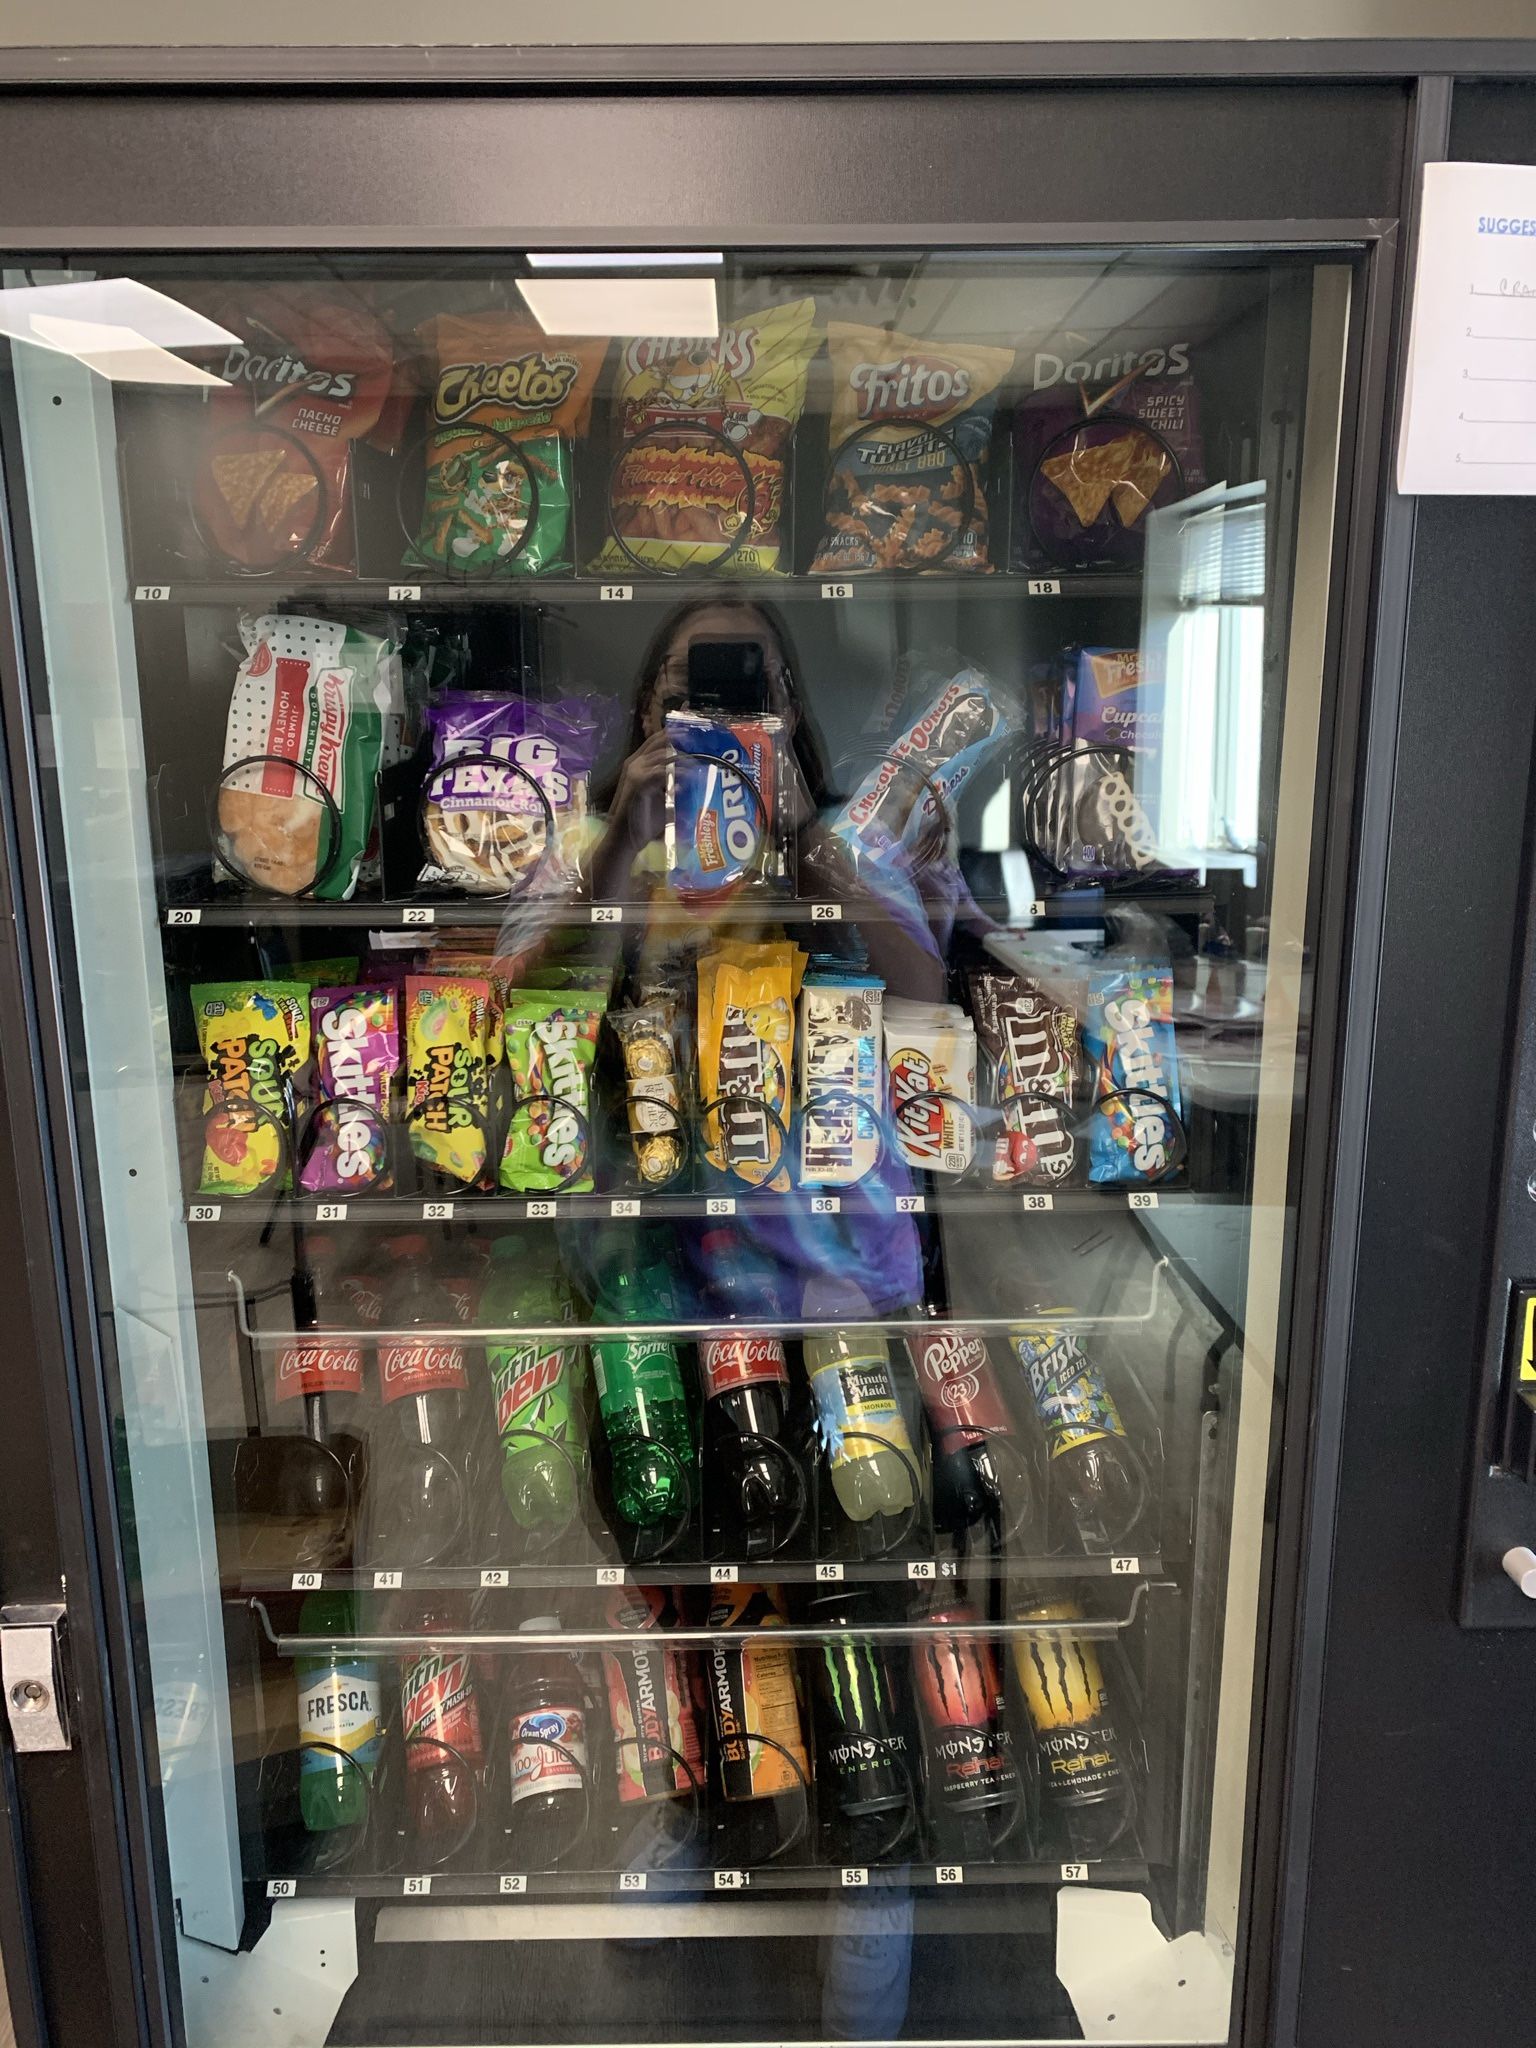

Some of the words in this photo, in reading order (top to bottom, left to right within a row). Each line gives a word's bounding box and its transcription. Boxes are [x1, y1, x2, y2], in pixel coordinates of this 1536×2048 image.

[222, 344, 356, 397] Doritos
[1033, 343, 1190, 391] Doritos
[435, 355, 572, 418] Cheetos
[849, 356, 972, 419] Fritos
[1147, 395, 1186, 408] SPICY
[297, 408, 342, 425] NACHO
[1138, 407, 1185, 419] SWEET
[292, 418, 340, 437] CHEESE
[1150, 419, 1185, 431] CHILI
[736, 550, 756, 563] 270
[143, 587, 163, 600] 10
[394, 588, 413, 600] 12
[606, 587, 625, 600] 14
[827, 585, 846, 598] 16
[1033, 581, 1053, 594] 18
[319, 673, 345, 736] Krispy
[275, 690, 290, 733] HONEY
[909, 684, 961, 750] DONUTS
[1102, 706, 1162, 727] Cupca
[443, 737, 560, 766] BIG
[430, 763, 569, 803] TEXAS
[440, 796, 516, 809] Cinnamon
[720, 749, 757, 861] OREO
[174, 911, 193, 923] 20
[407, 910, 427, 922] 22
[595, 909, 614, 921] 24
[815, 906, 835, 918] 26
[285, 998, 304, 1022] SOUR
[248, 1039, 286, 1125] SOUR
[1104, 998, 1168, 1172] Skittles
[321, 1008, 377, 1180] Skittles
[535, 1021, 587, 1167] Skittles
[943, 1119, 955, 1150] WHITE
[948, 1155, 956, 1168] 220
[711, 1201, 728, 1212] 35
[815, 1199, 833, 1211] 36
[900, 1198, 917, 1210] 37
[1028, 1197, 1046, 1208] 38
[1133, 1195, 1151, 1207] 39
[195, 1207, 214, 1220] 30
[322, 1206, 339, 1218] 31
[427, 1205, 445, 1217] 32
[531, 1204, 549, 1215] 33
[615, 1202, 633, 1214] 34
[628, 1339, 668, 1361] Sprite
[925, 1337, 983, 1382] Pepper
[1059, 1366, 1075, 1385] ICED
[1075, 1356, 1088, 1371] TEA
[846, 1373, 889, 1389] Minute
[856, 1383, 887, 1399] Maid
[951, 1383, 967, 1399] 23
[912, 1564, 929, 1576] 46
[941, 1563, 958, 1577] $1
[1115, 1559, 1132, 1571] 47
[484, 1572, 501, 1584] 42
[600, 1570, 618, 1583] 43
[714, 1568, 731, 1580] 44
[820, 1566, 837, 1578] 45
[297, 1574, 315, 1586] 40
[378, 1573, 395, 1585] 41
[540, 1722, 560, 1739] Spray
[981, 1776, 995, 1785] TEA
[1063, 1772, 1102, 1786] LEMONADE
[846, 1871, 862, 1883] 55
[940, 1869, 956, 1881] 56
[1065, 1866, 1082, 1878] 57
[503, 1878, 520, 1890] 52
[624, 1875, 640, 1887] 53
[718, 1873, 734, 1885] 54
[272, 1882, 289, 1895] 50
[408, 1880, 424, 1892] 51
